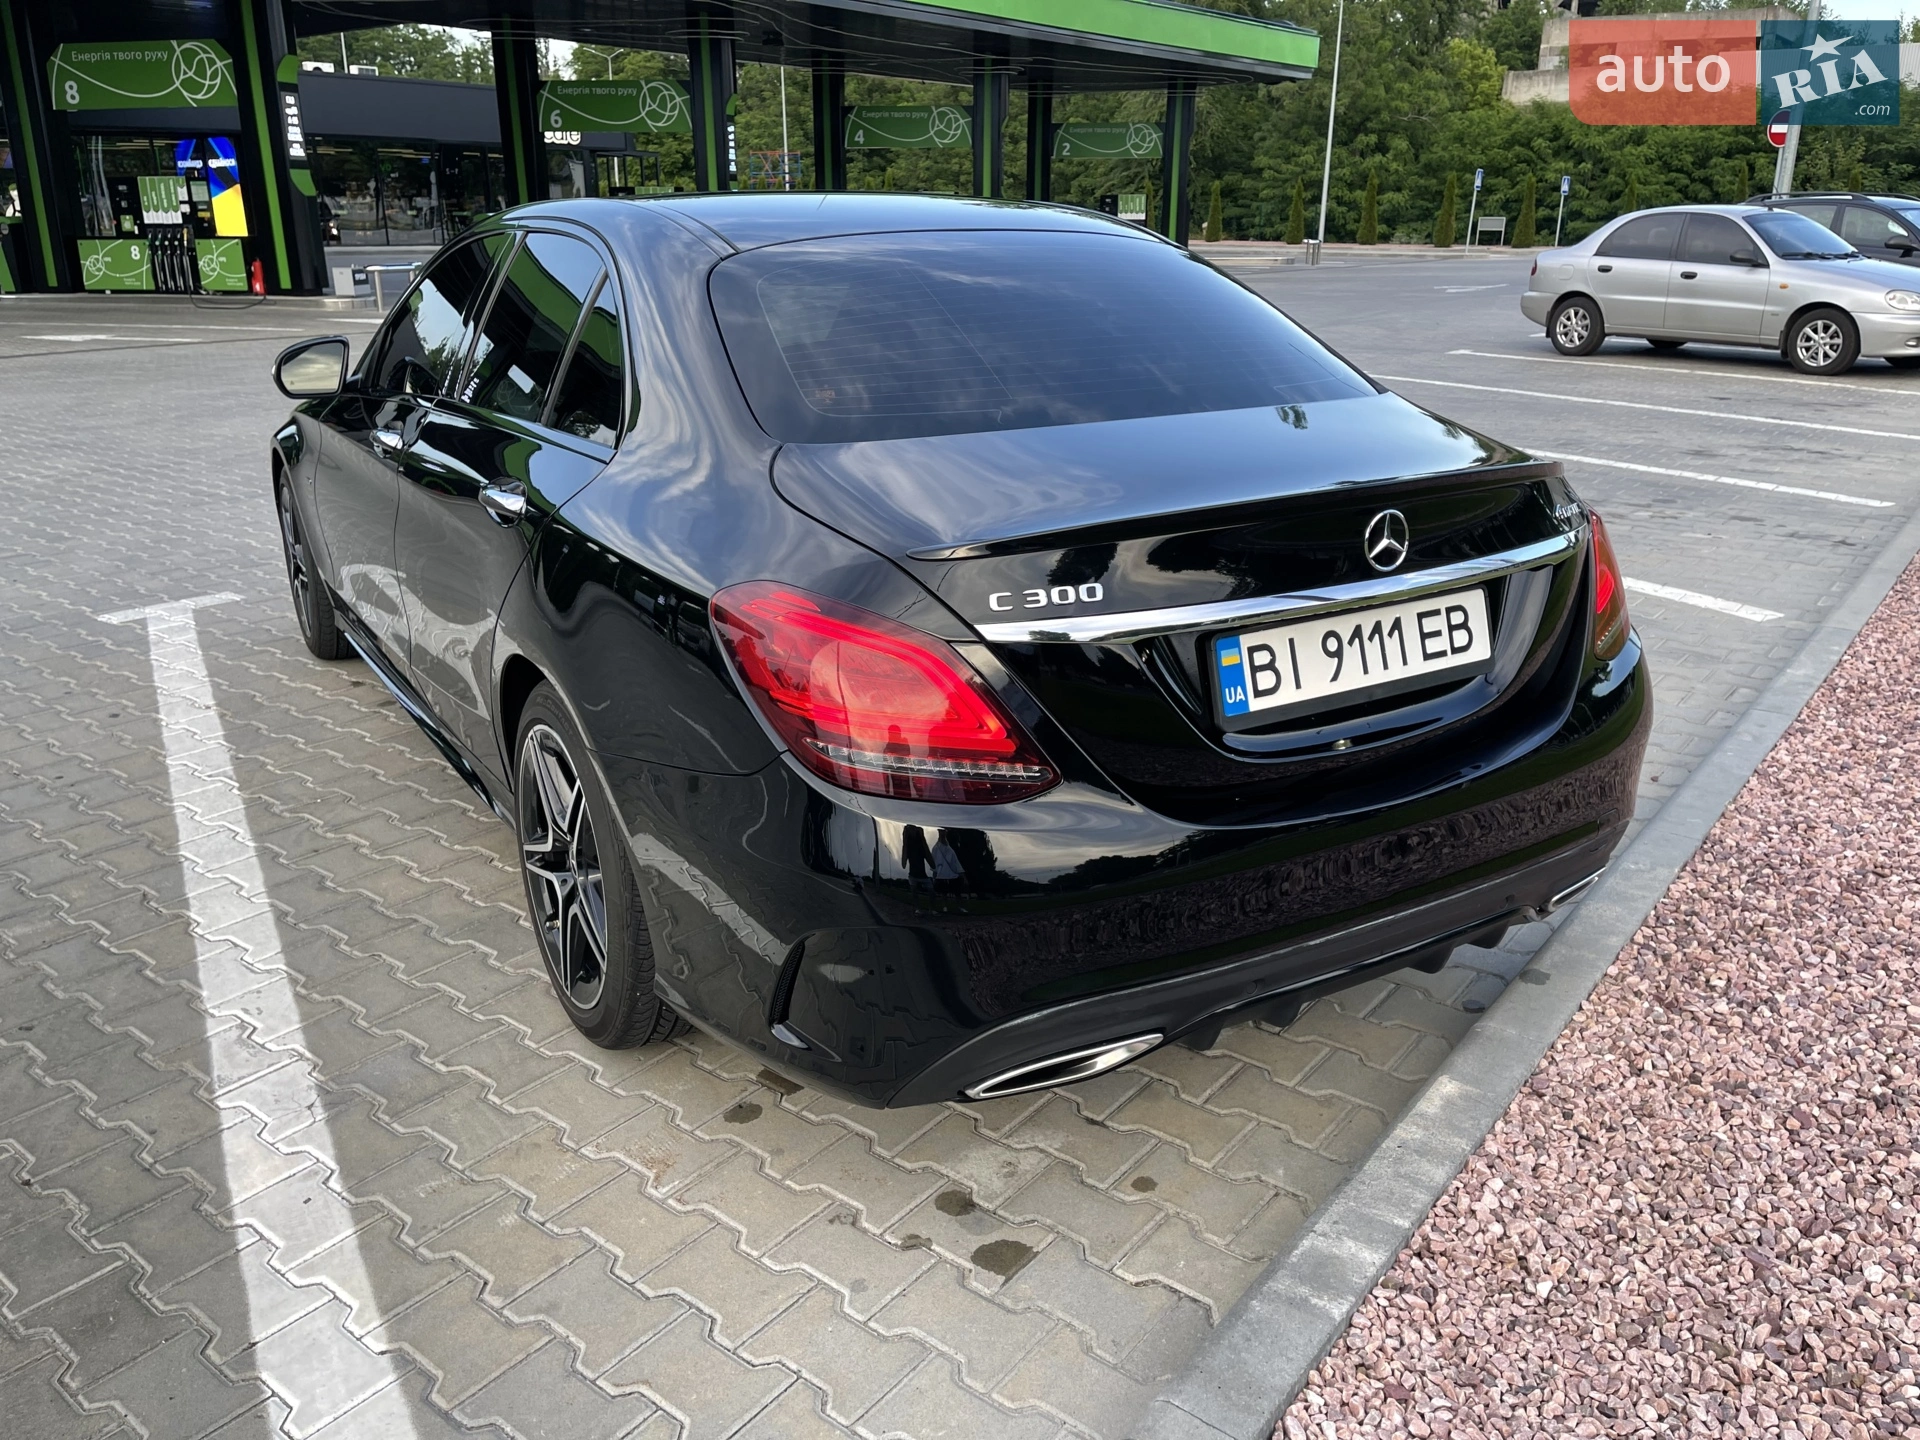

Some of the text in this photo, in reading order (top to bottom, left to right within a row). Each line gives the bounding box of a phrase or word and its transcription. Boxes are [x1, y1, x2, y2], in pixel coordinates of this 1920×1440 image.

[71, 50, 168, 63] Енергія твого руху
[64, 80, 80, 105] 8
[557, 85, 638, 96] Енергія твого руху
[550, 109, 562, 128] 6
[854, 129, 865, 144] 4
[1062, 142, 1071, 156] 2
[130, 245, 141, 260] 8
[989, 582, 1104, 612] C 300
[1246, 604, 1474, 699] BI 9111 EB
[1225, 685, 1245, 704] UA
